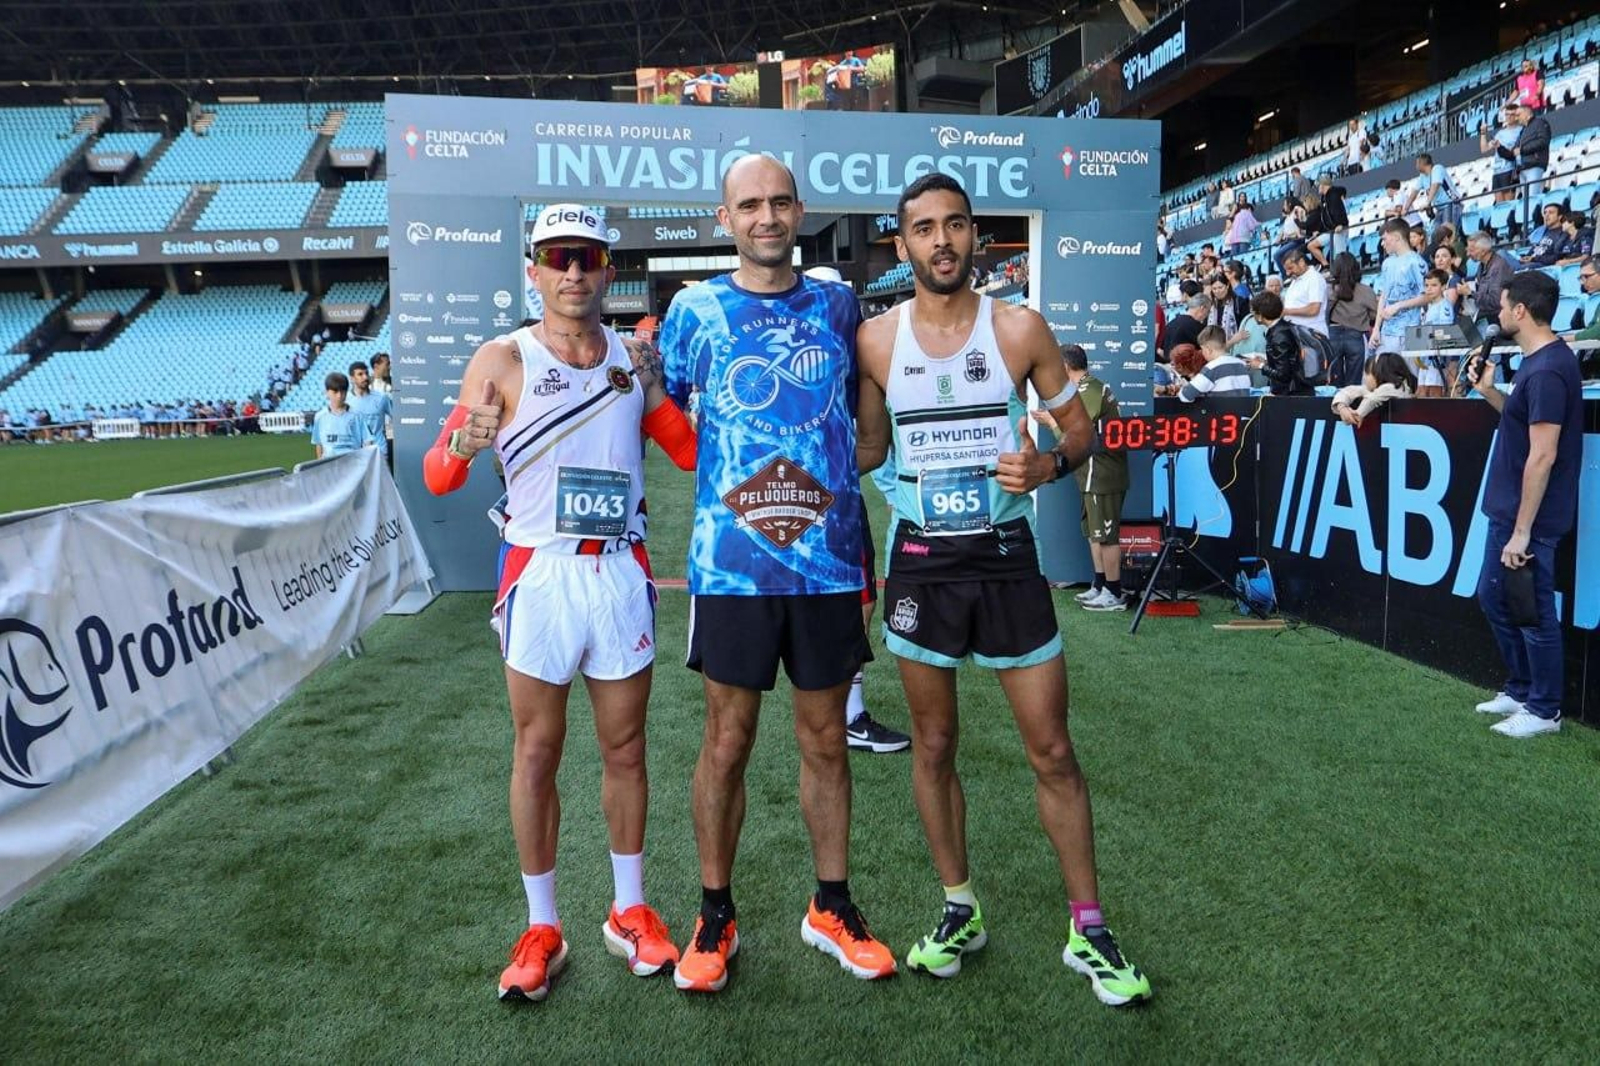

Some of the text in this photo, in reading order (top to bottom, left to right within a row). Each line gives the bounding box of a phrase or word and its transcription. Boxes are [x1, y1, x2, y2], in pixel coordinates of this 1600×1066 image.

[767, 52, 783, 62] LG
[1137, 20, 1186, 83] hummel
[425, 129, 505, 146] FUNDACIÓN
[535, 122, 692, 141] CARREIRA POPULAR
[963, 131, 1025, 147] Profand
[425, 144, 469, 158] CELTA
[1080, 149, 1148, 165] FUNDACIÓN
[536, 136, 795, 191] INVASI
[1080, 163, 1118, 176] CELTA
[546, 208, 597, 228] ciele
[434, 227, 502, 243] Profand
[655, 226, 697, 240] Siweb
[161, 241, 212, 255] Estrella
[214, 238, 261, 253] Galicia
[302, 236, 354, 250] Recalvi
[1083, 240, 1141, 256] Profand
[741, 316, 819, 336] RUNNERS
[745, 411, 826, 436] AND BIKERS
[1104, 414, 1238, 449] 00:38:13
[931, 426, 998, 443] HYUNDAI
[952, 447, 999, 461] SANTIAGO
[766, 481, 797, 490] TELMO
[564, 492, 625, 518] 1043
[739, 489, 821, 506] PELUQUEROS
[931, 488, 981, 515] 965
[74, 566, 264, 712] Profand
[271, 561, 338, 612] Leading
[331, 547, 360, 579] the
